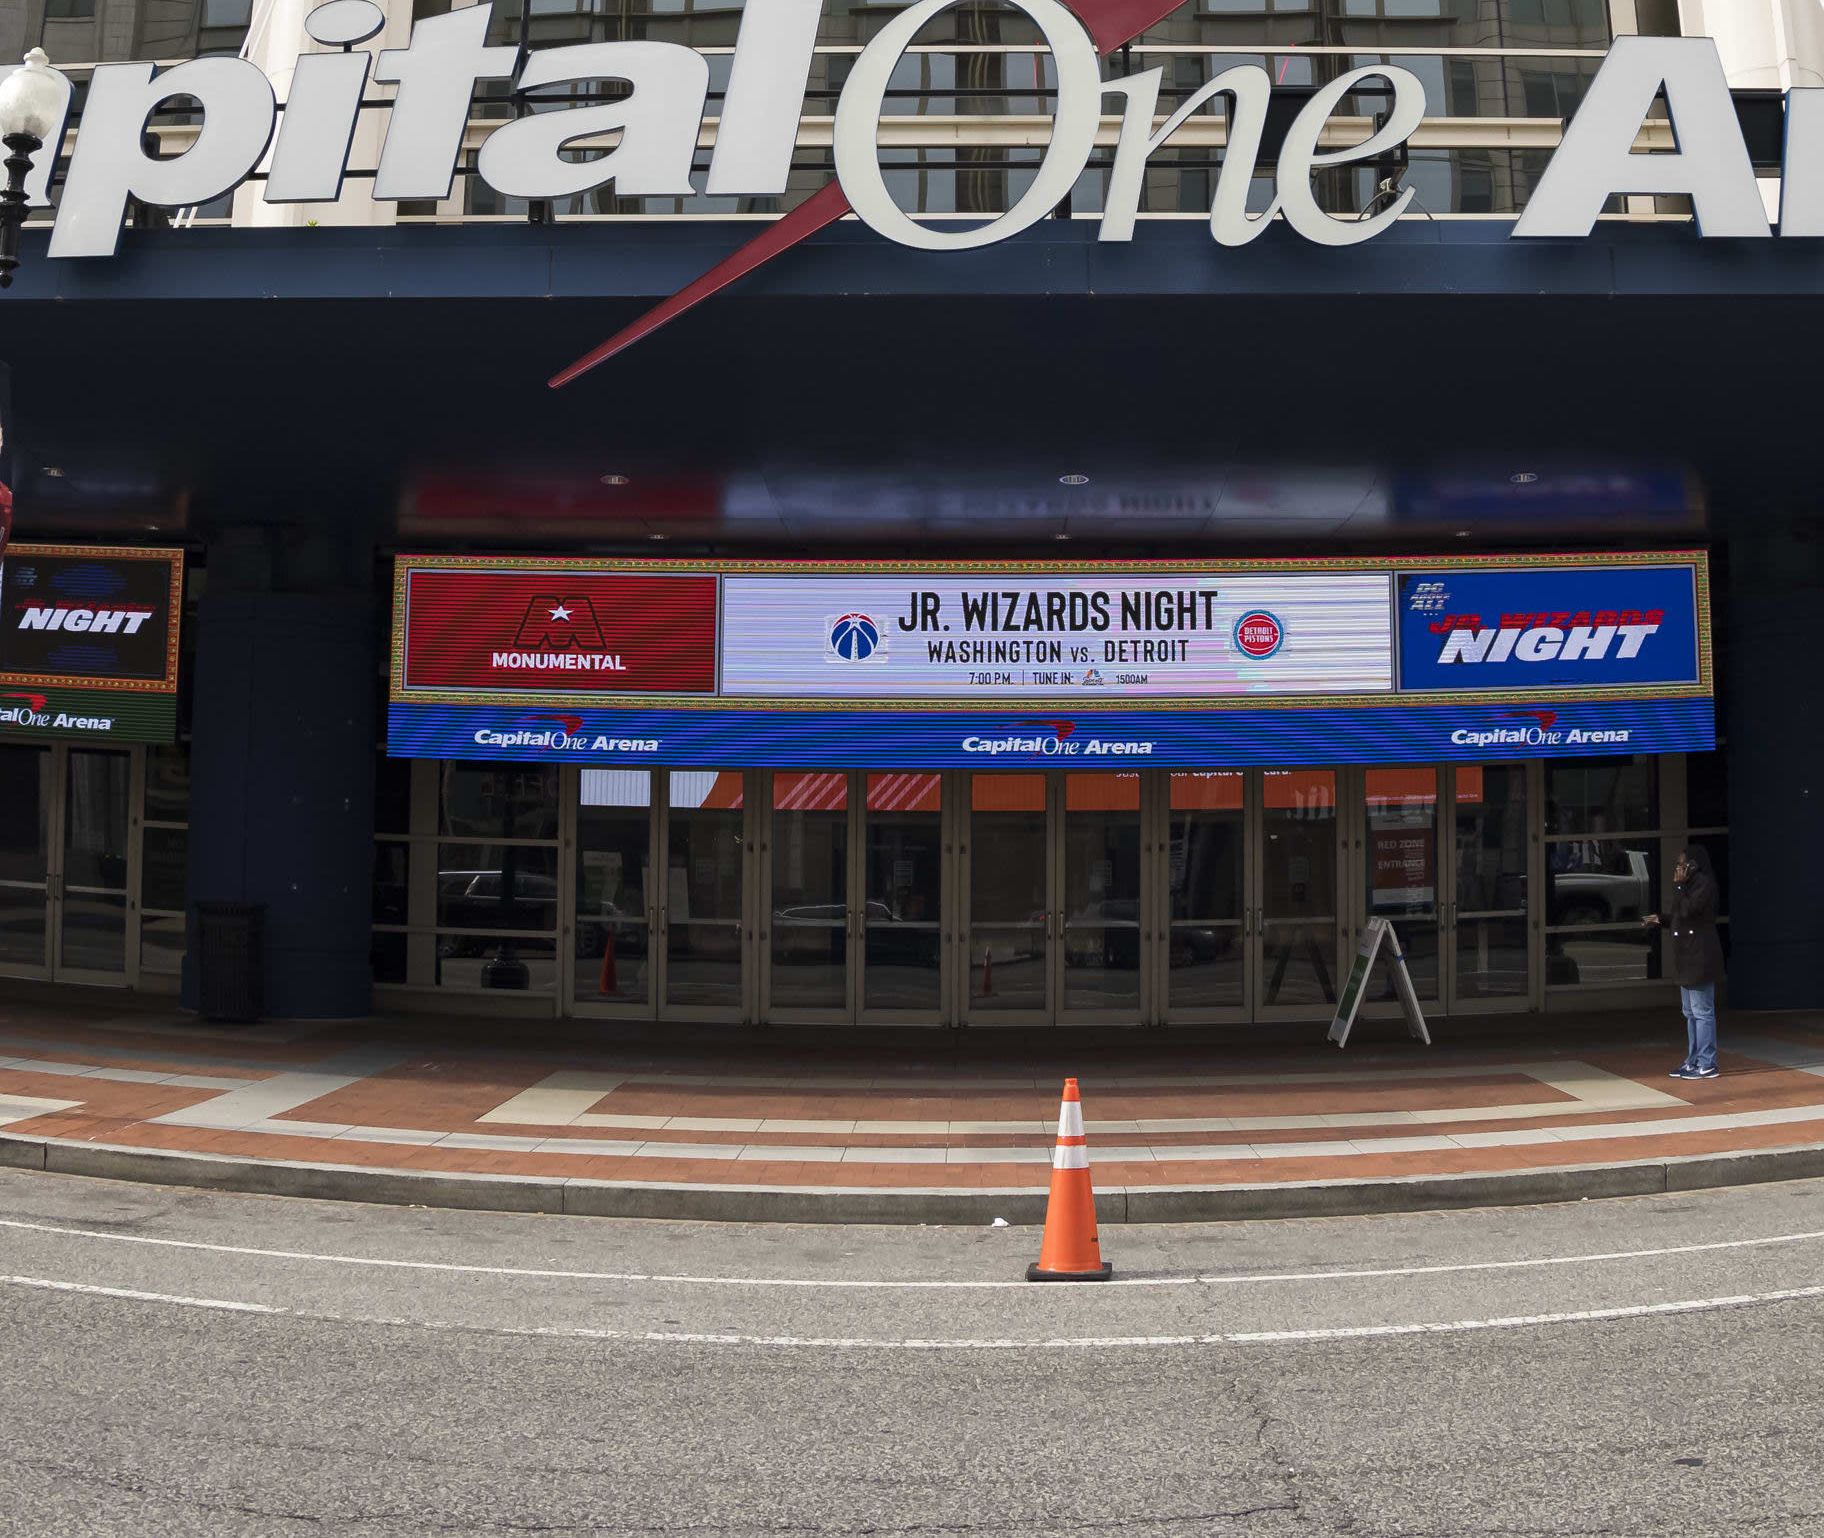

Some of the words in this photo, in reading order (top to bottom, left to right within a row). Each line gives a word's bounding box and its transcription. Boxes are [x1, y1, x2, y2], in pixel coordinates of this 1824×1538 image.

[897, 591, 950, 633] JR.
[961, 591, 1111, 632] WIZARDS
[1121, 590, 1218, 632] NIGHT
[1499, 609, 1666, 631] WIZARDS
[18, 607, 153, 635] NIGHT
[1244, 626, 1274, 635] DETROIT
[1244, 634, 1274, 643] PISTONS
[927, 640, 1062, 663] WASHINGTON
[1104, 639, 1189, 663] DETROIT
[1437, 624, 1660, 663] NIGHT
[492, 651, 627, 671] MONUMENTAL
[968, 671, 991, 685] 7:00
[994, 672, 1014, 685] P.M.
[1032, 671, 1060, 685] TUNE
[1061, 672, 1075, 685] IN:
[1115, 673, 1149, 685] 1500AM
[52, 713, 113, 731] Arena
[591, 734, 658, 752] Arena
[1565, 729, 1629, 744] Arena
[1083, 739, 1153, 755] Arena
[1377, 840, 1397, 850] RED
[1399, 838, 1425, 849] ZONE
